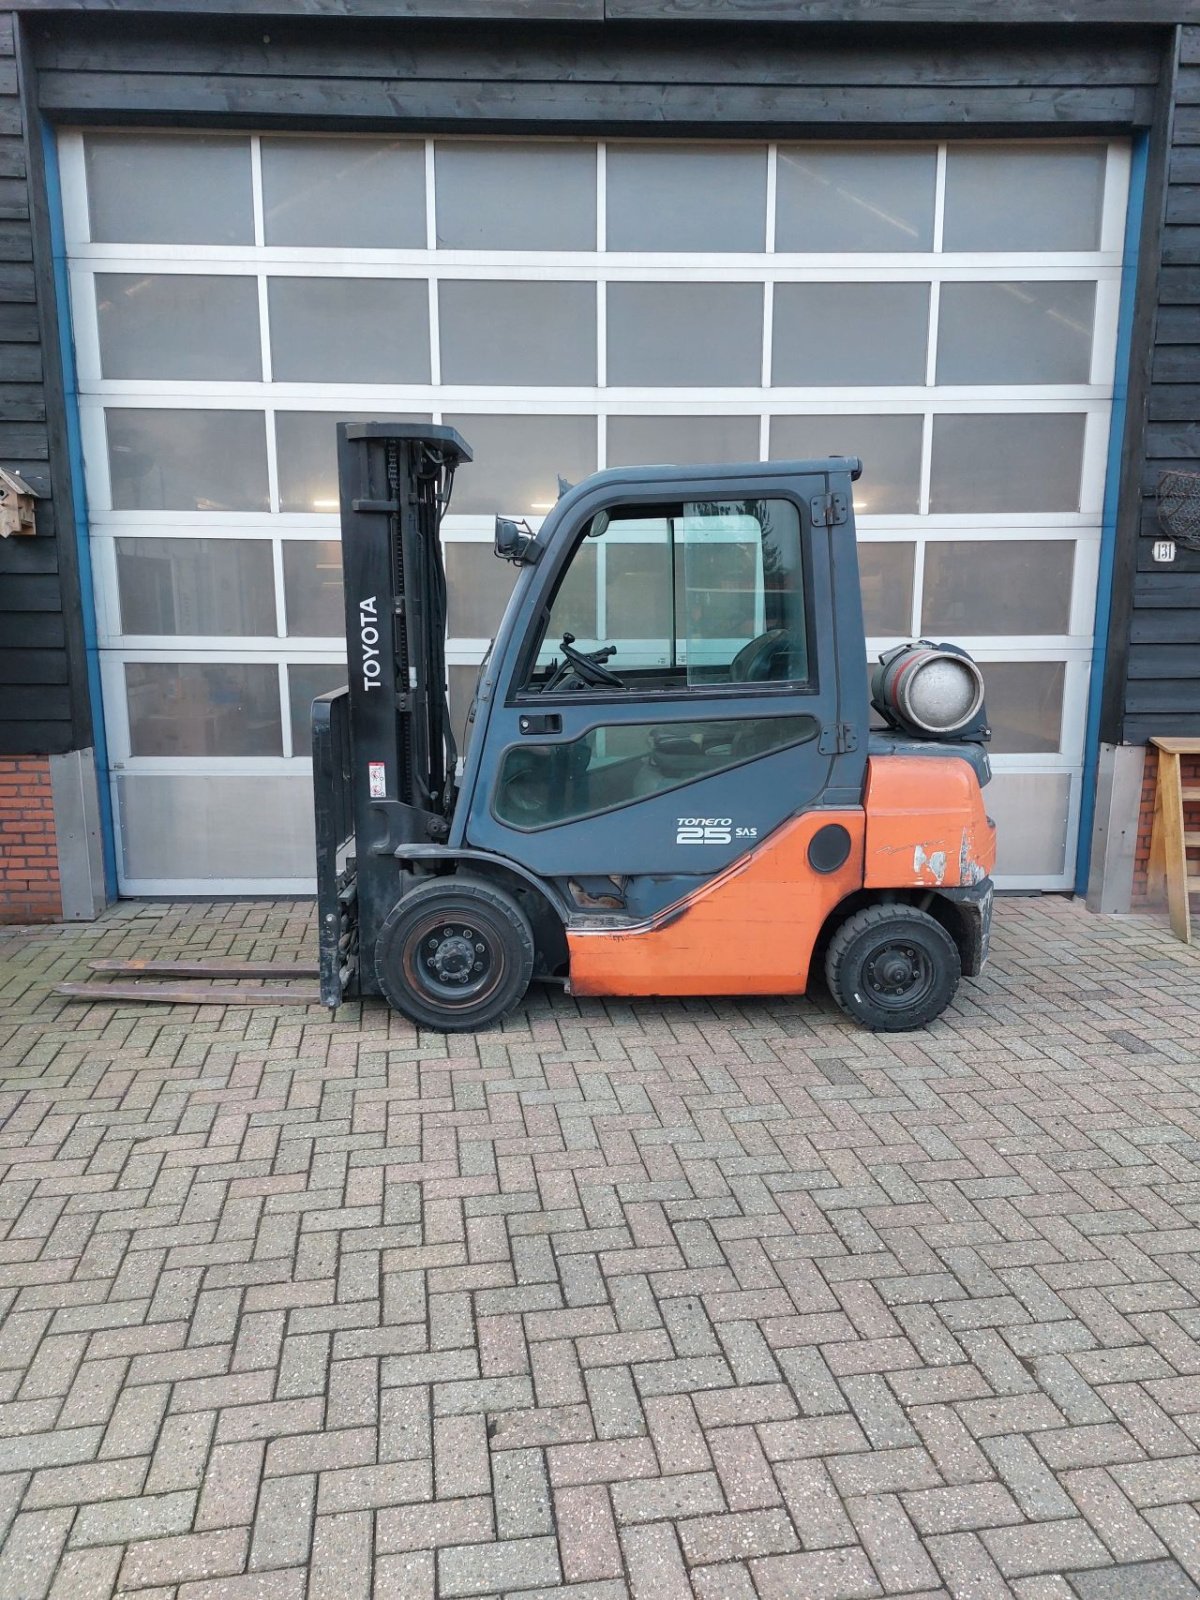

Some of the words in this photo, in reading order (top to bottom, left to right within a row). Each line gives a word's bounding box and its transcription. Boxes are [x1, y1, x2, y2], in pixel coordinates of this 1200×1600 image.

[1157, 543, 1172, 560] 131
[359, 595, 382, 692] TOYOTA
[676, 827, 732, 845] 25
[735, 827, 758, 836] SAS
